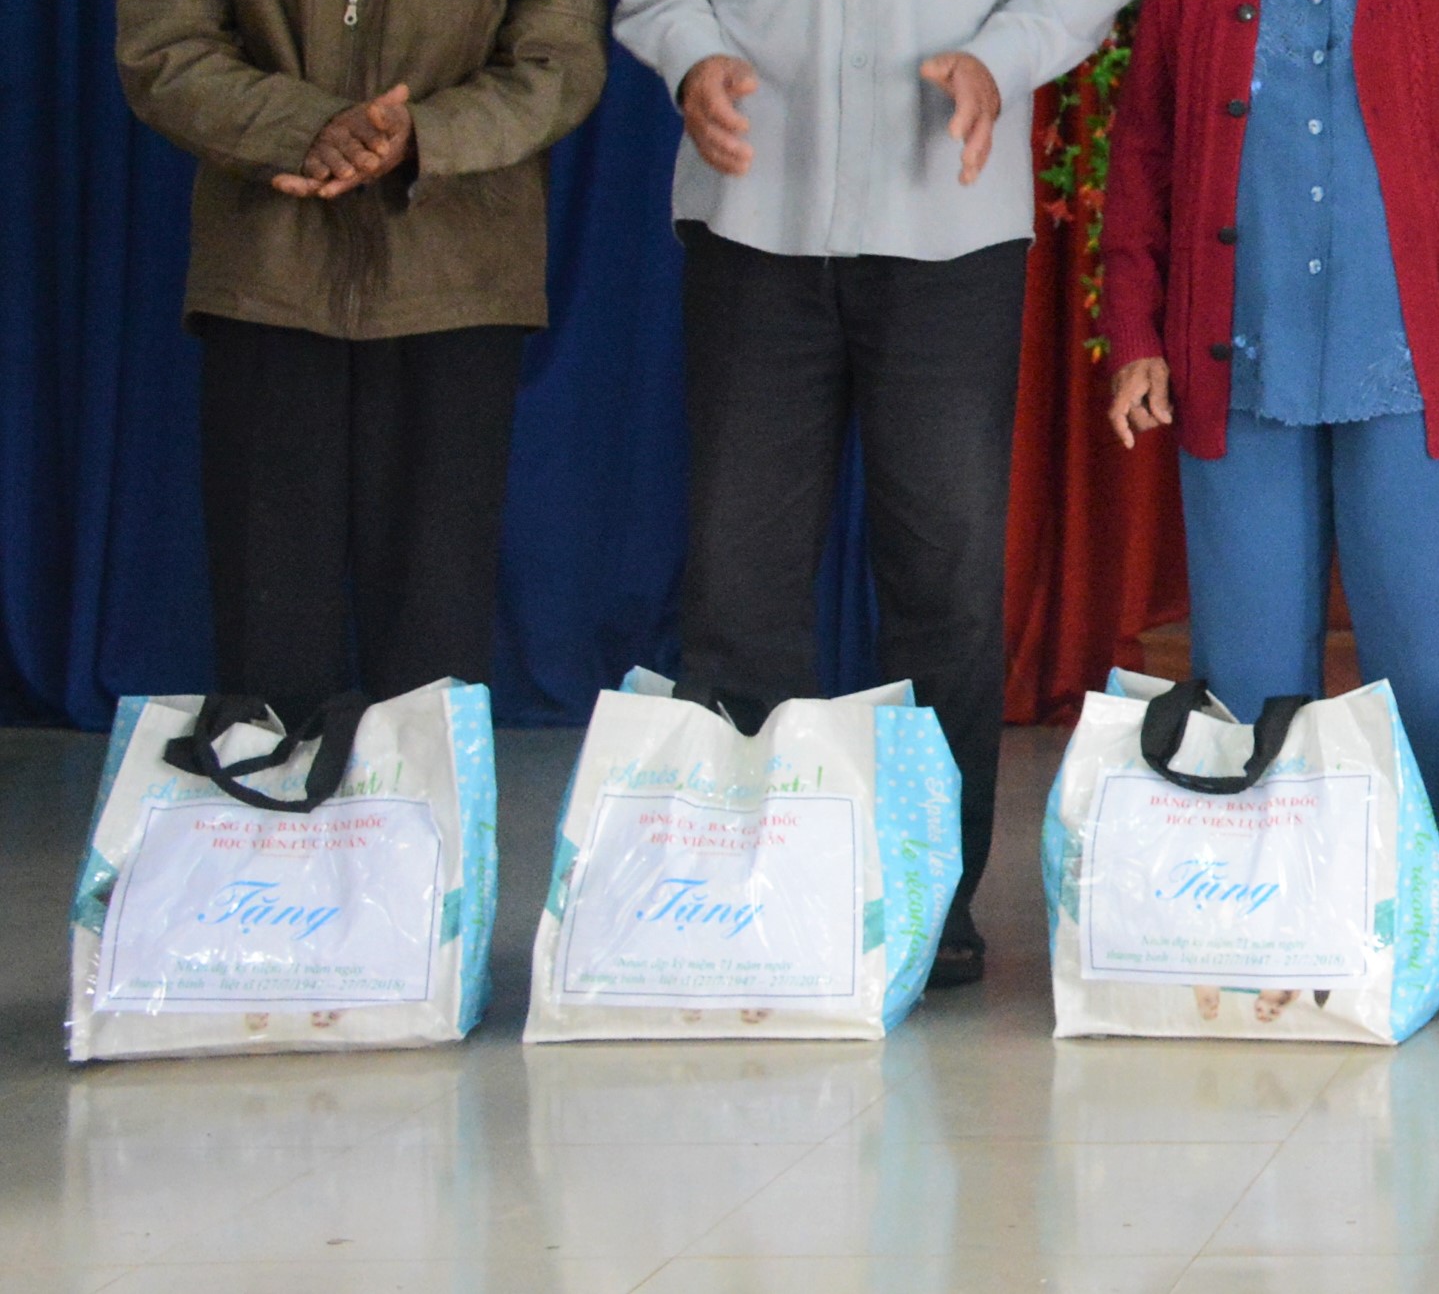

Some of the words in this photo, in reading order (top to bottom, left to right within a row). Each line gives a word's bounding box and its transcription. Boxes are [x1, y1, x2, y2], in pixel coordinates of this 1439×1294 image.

[196, 879, 343, 941] Tặng
[635, 877, 767, 942] Tặng
[1153, 858, 1281, 916] Tặng
